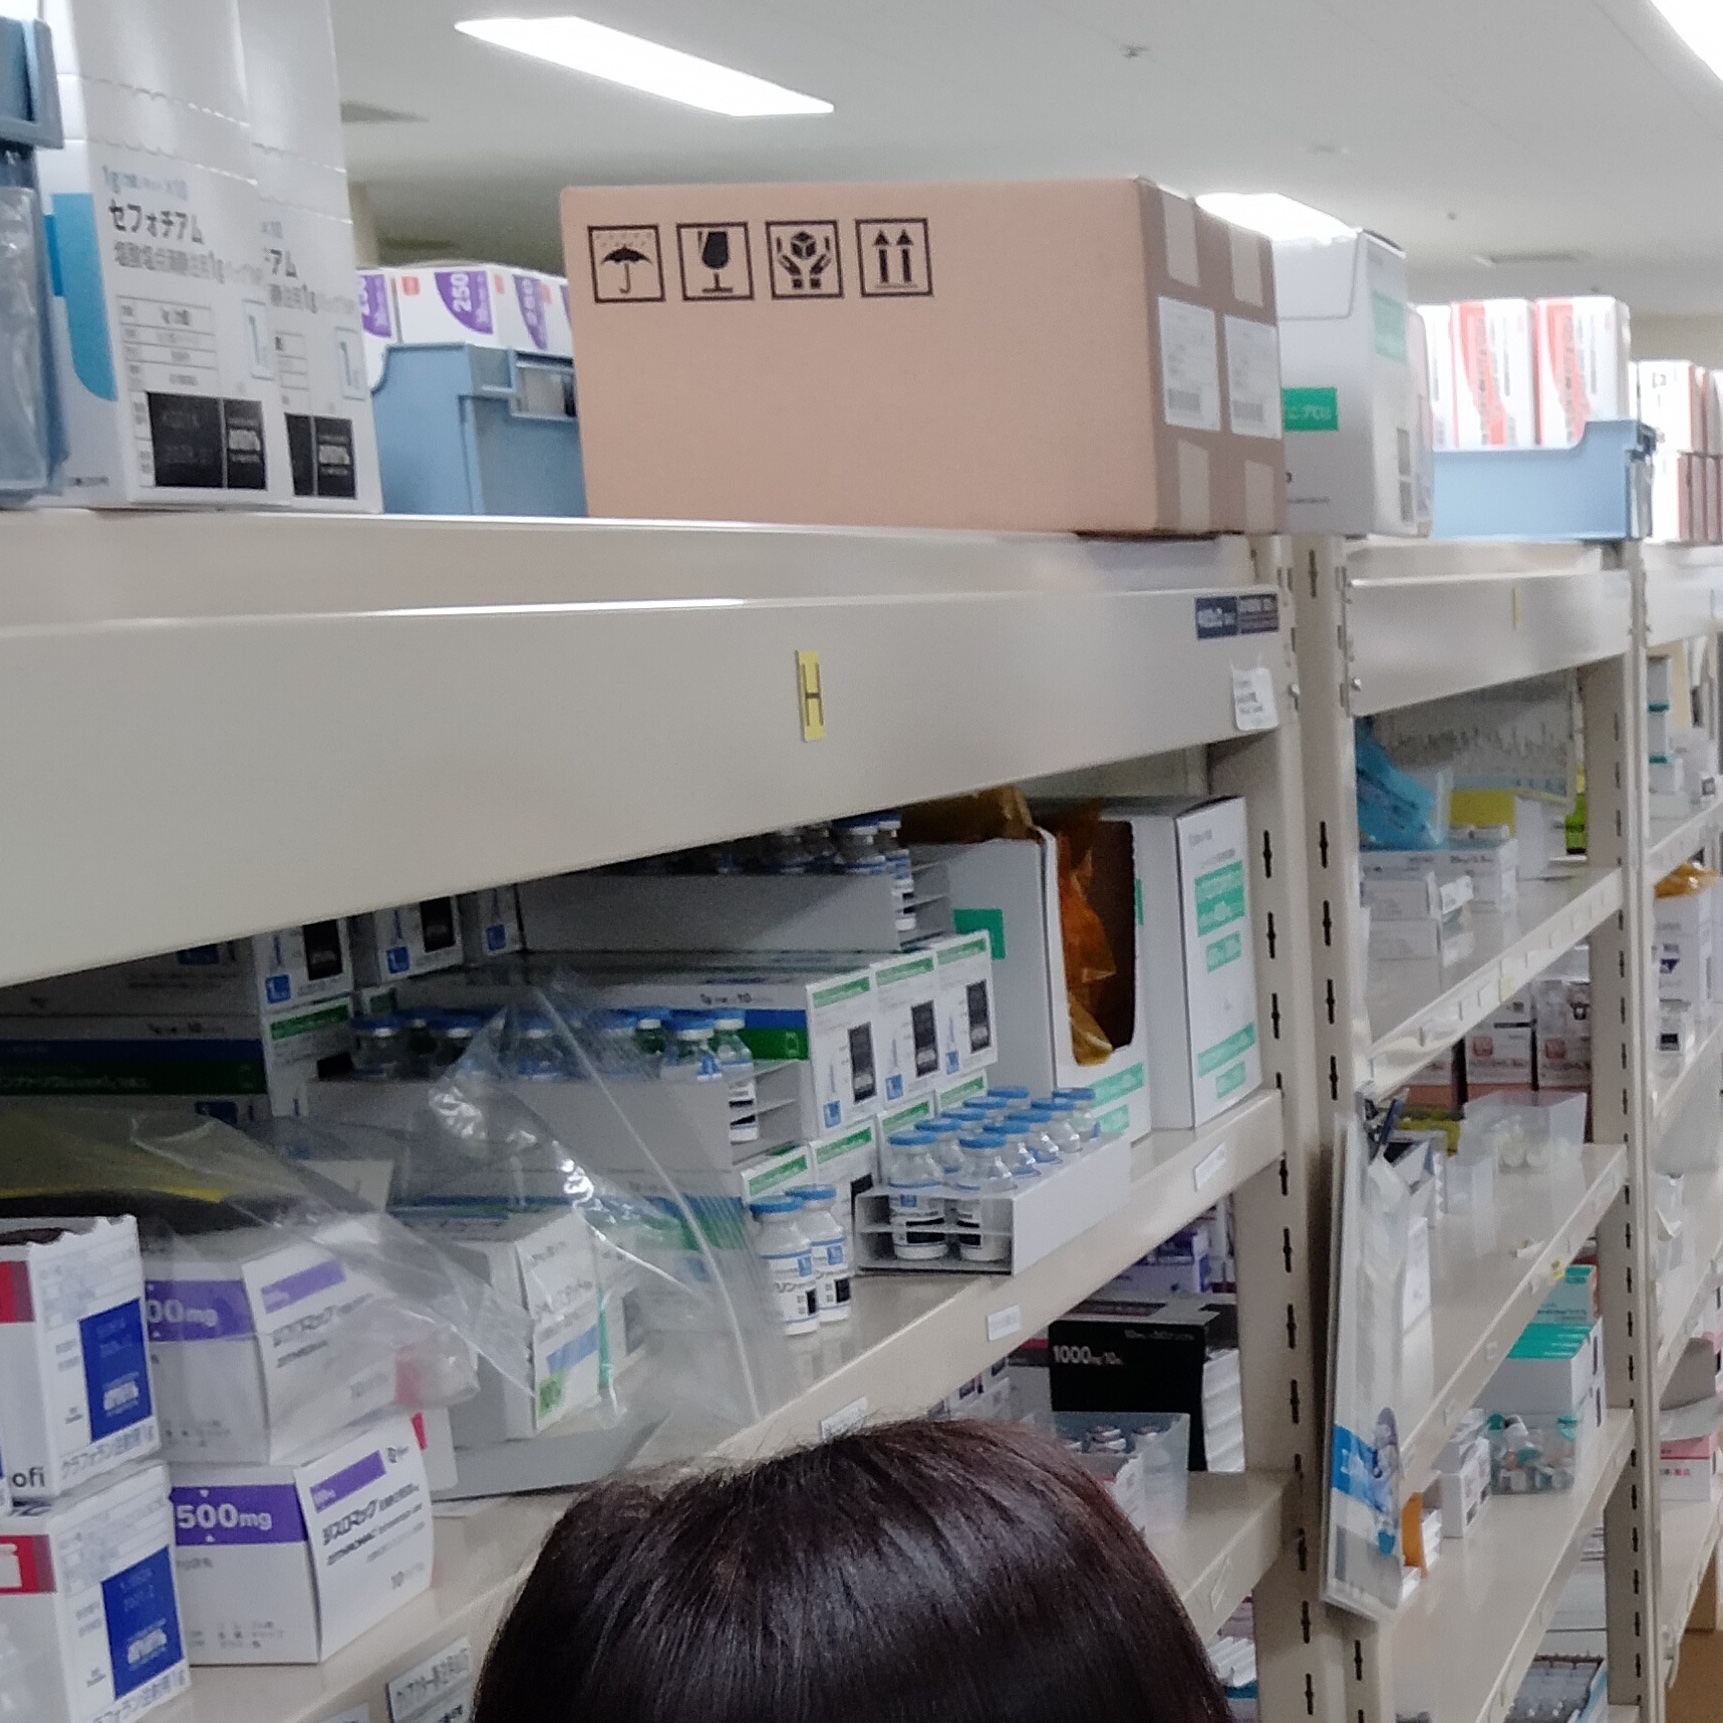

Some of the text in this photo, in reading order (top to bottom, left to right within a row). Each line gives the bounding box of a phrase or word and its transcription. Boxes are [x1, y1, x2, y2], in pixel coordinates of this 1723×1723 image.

[802, 663, 824, 727] H
[146, 1299, 219, 1328] 00mg
[176, 1503, 273, 1531] 500mg
